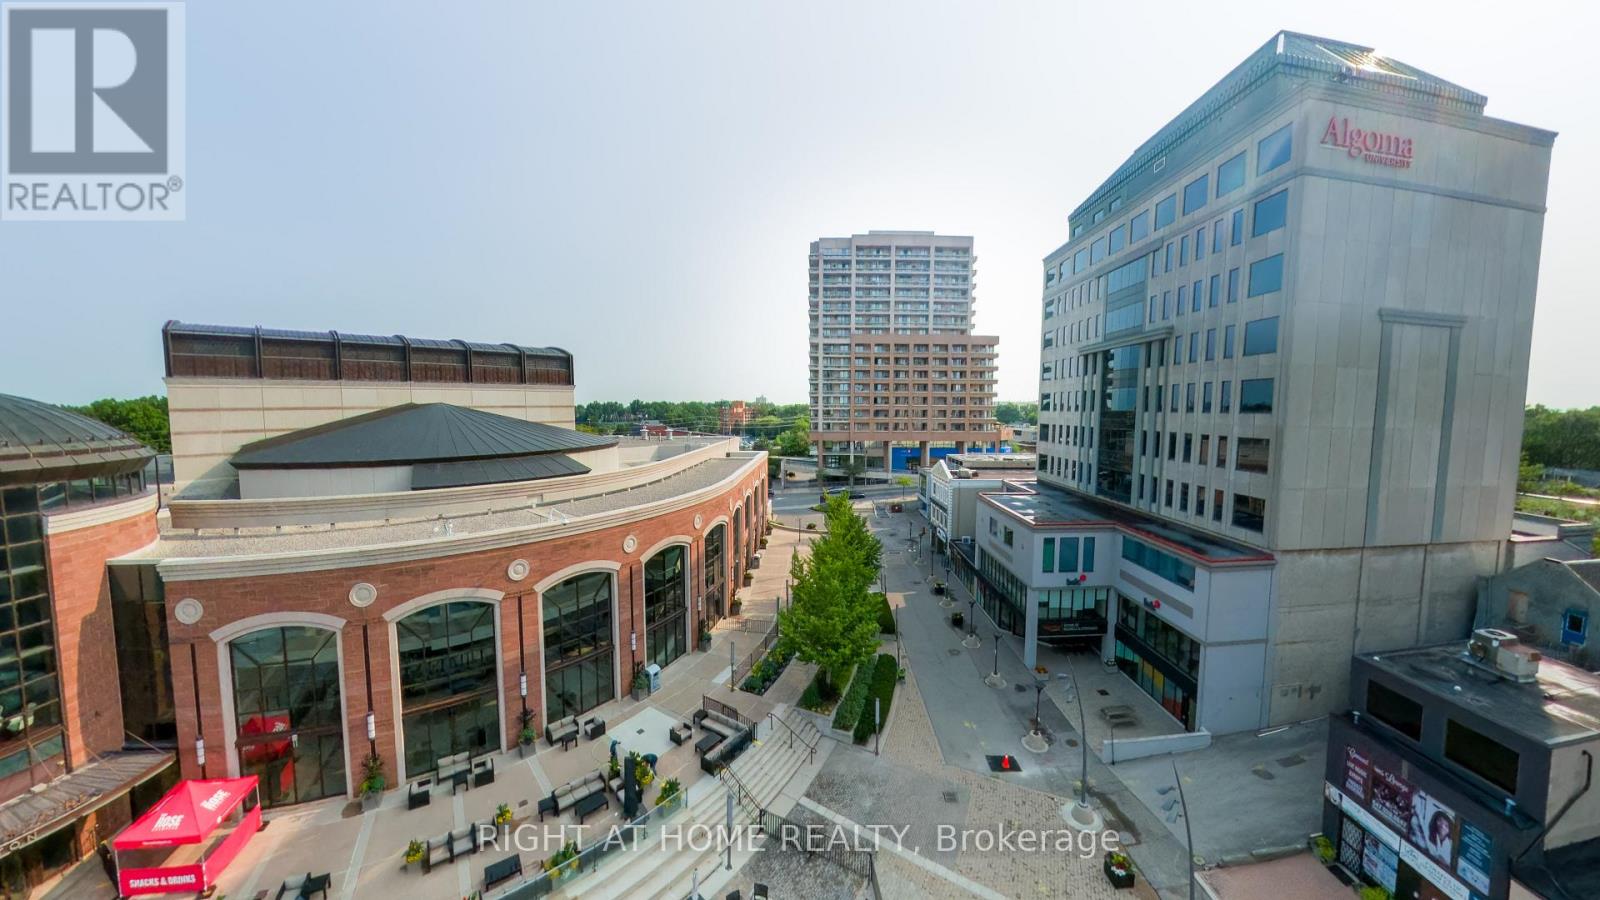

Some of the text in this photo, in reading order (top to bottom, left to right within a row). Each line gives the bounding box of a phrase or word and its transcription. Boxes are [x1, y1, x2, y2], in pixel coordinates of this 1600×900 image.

[1320, 113, 1413, 158] Algoma
[129, 878, 160, 889] SNACKS
[167, 874, 196, 886] DRINKS
